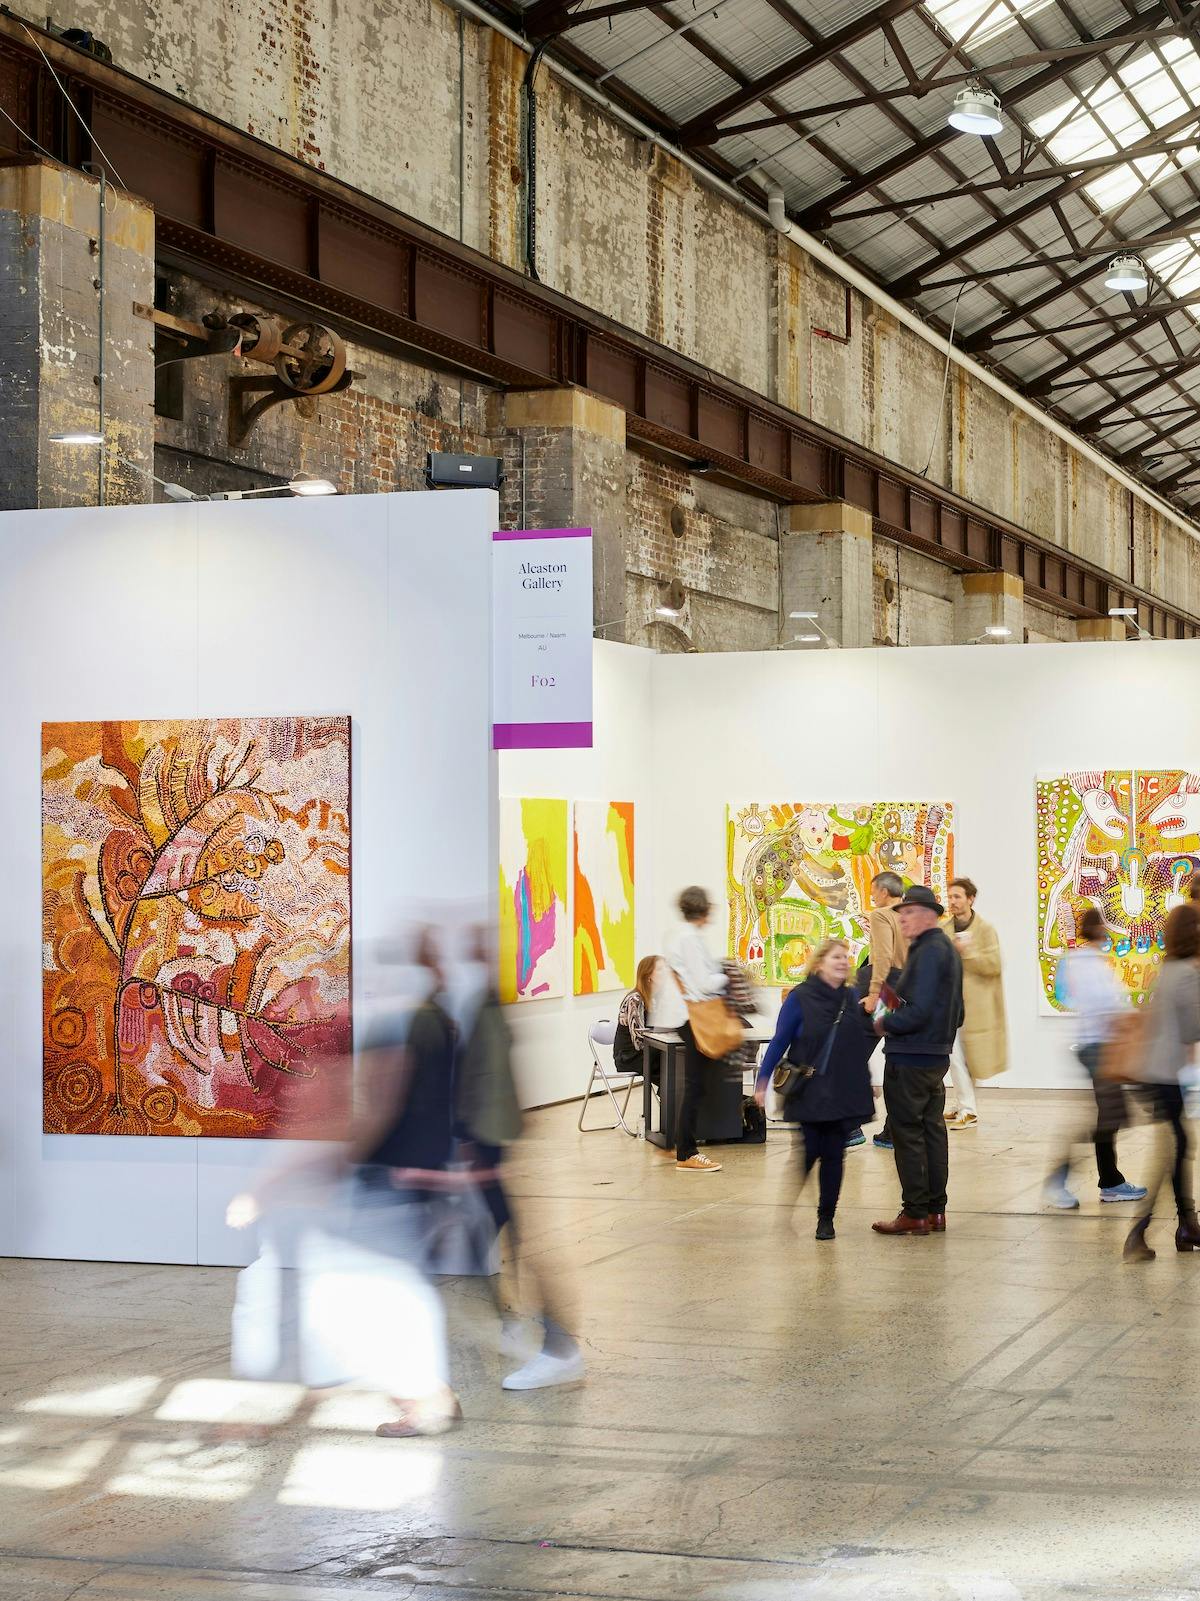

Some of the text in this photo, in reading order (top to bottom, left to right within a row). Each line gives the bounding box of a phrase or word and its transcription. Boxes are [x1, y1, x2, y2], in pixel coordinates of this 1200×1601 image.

[519, 563, 567, 574] Alcaston
[522, 577, 563, 592] Gallery
[531, 675, 555, 687] F02
